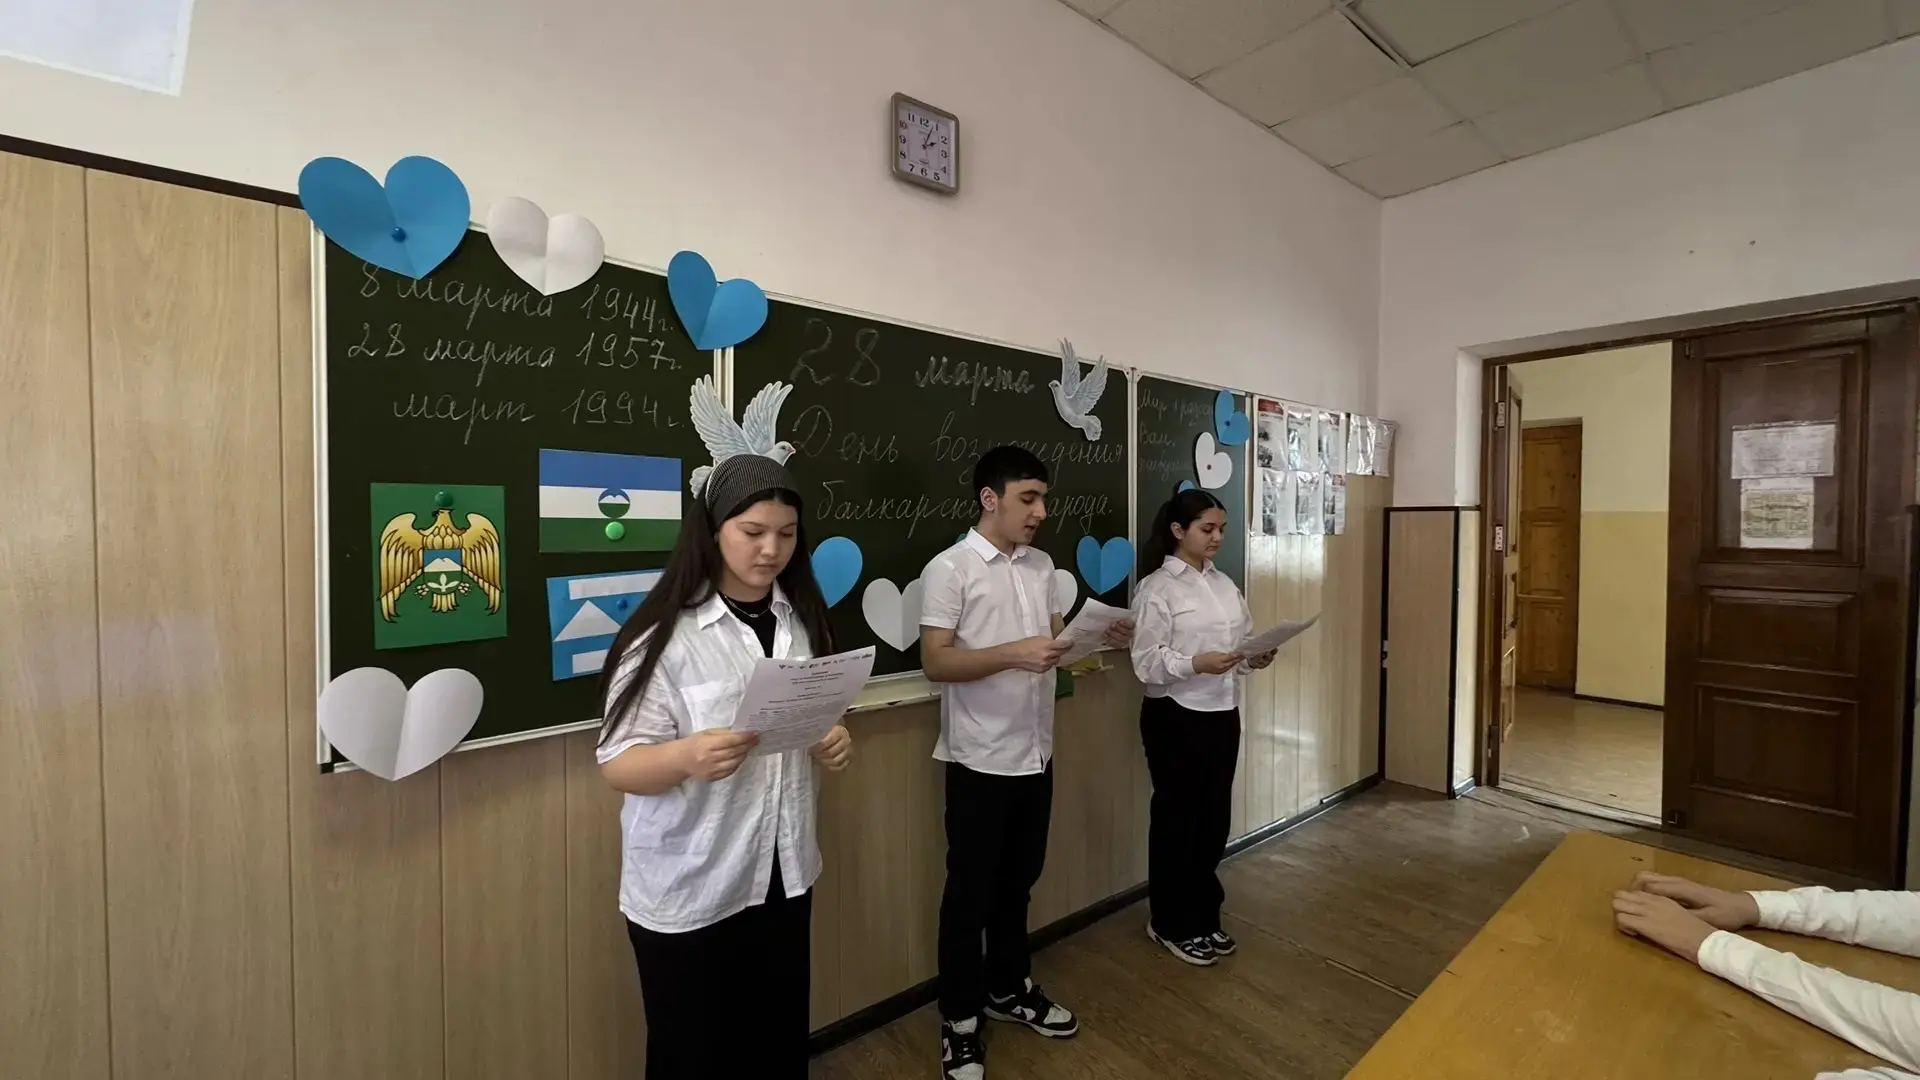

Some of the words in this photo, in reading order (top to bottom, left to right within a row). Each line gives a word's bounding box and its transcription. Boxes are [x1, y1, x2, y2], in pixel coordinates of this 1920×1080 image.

[908, 112, 915, 122] 11
[920, 117, 930, 127] 12
[899, 120, 908, 129] 10
[899, 134, 906, 144] 9
[941, 135, 949, 145] 2
[899, 150, 906, 159] 8
[940, 149, 948, 158] 3
[908, 163, 915, 172] 7
[920, 167, 928, 176] 6
[940, 166, 947, 174] 4
[933, 172, 940, 181] 5
[361, 262, 381, 298] 8
[397, 278, 553, 331] марта
[348, 322, 406, 358] 28
[424, 328, 556, 387] марта
[789, 317, 881, 387] 28
[914, 355, 1036, 407] марта
[393, 393, 536, 446] март
[792, 404, 900, 463] День
[930, 410, 1123, 489] возждения
[816, 480, 981, 539] балкарско
[1047, 493, 1113, 536] арода.
